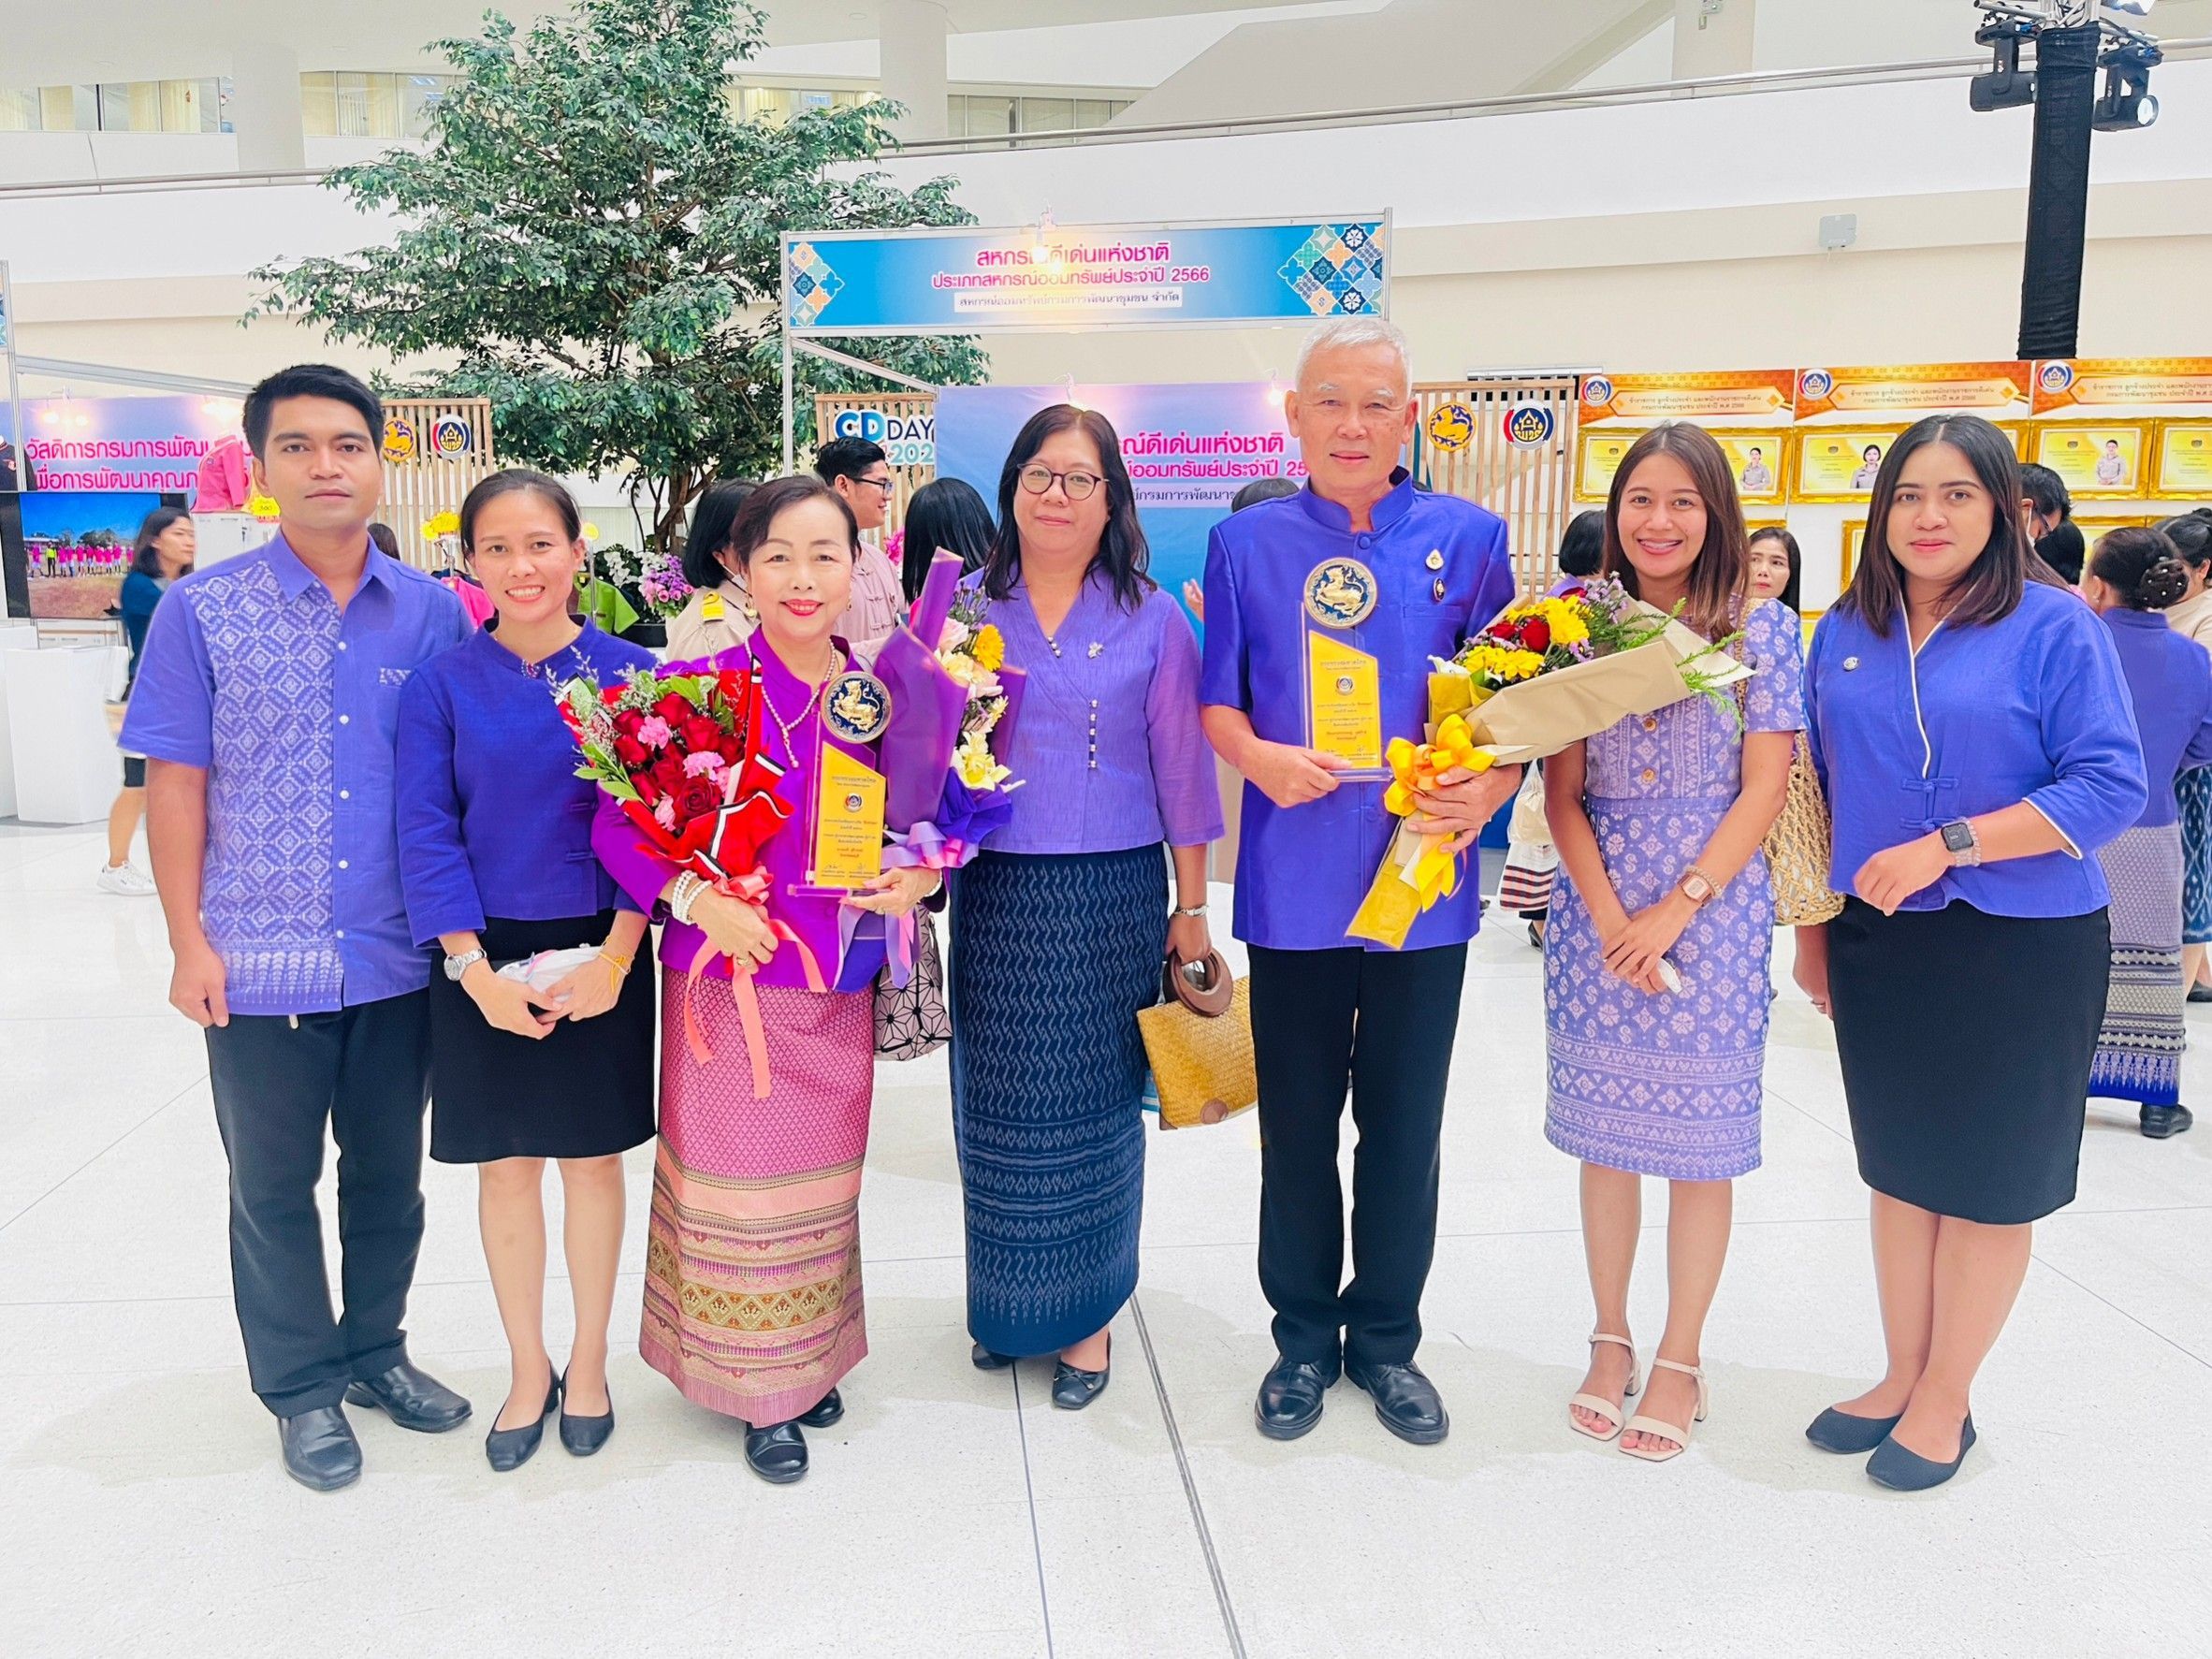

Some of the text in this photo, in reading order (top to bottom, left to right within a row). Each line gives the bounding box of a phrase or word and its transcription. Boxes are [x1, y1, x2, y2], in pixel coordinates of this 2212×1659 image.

[976, 241, 1171, 268] สหกร์ดีเด่นแห่งชาติ
[1171, 268, 1210, 283] 2566
[887, 418, 934, 441] DAY
[1121, 431, 1285, 456] ณ์ดีเด่นแห่งชาติ
